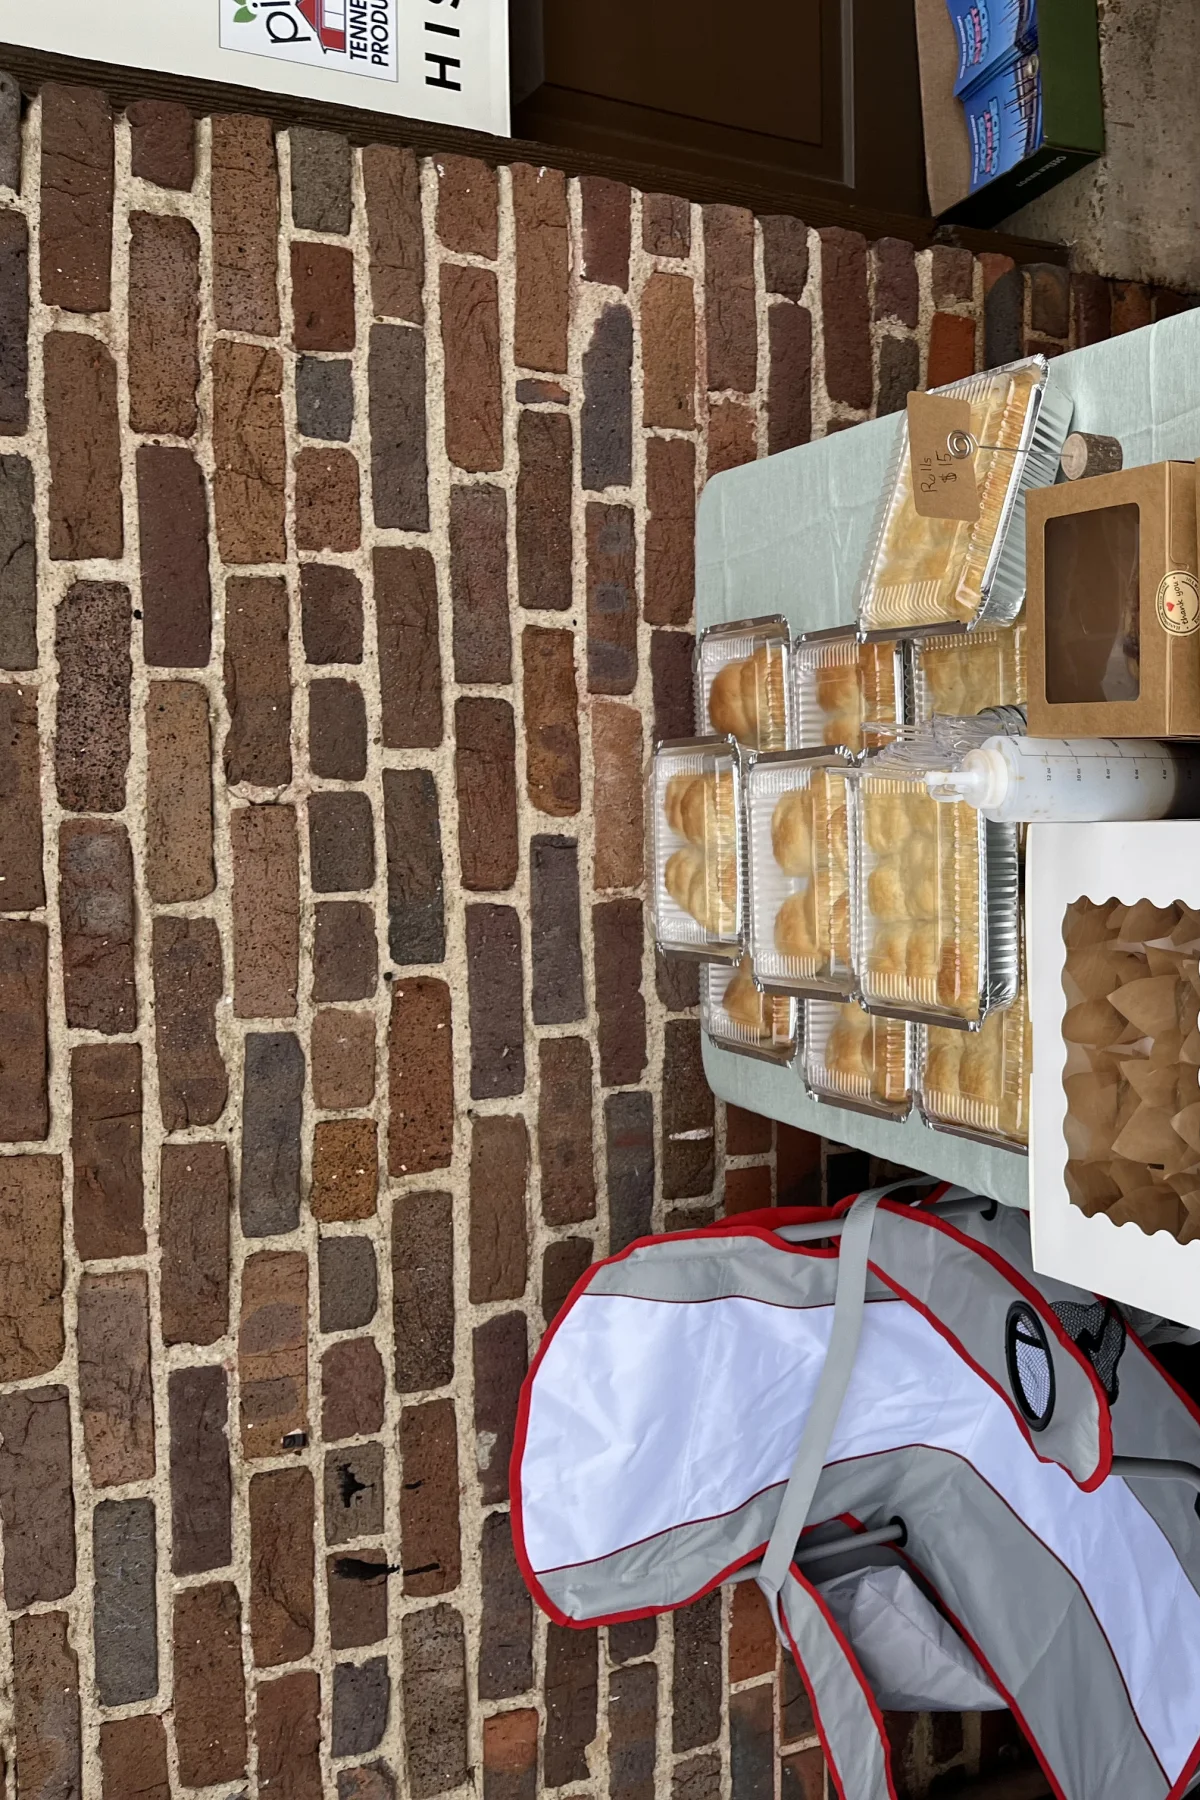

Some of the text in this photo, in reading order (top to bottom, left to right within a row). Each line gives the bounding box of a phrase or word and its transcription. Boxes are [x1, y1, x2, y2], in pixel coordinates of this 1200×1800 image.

[920, 457, 937, 492] Rolls
[1173, 580, 1188, 625] thank you
